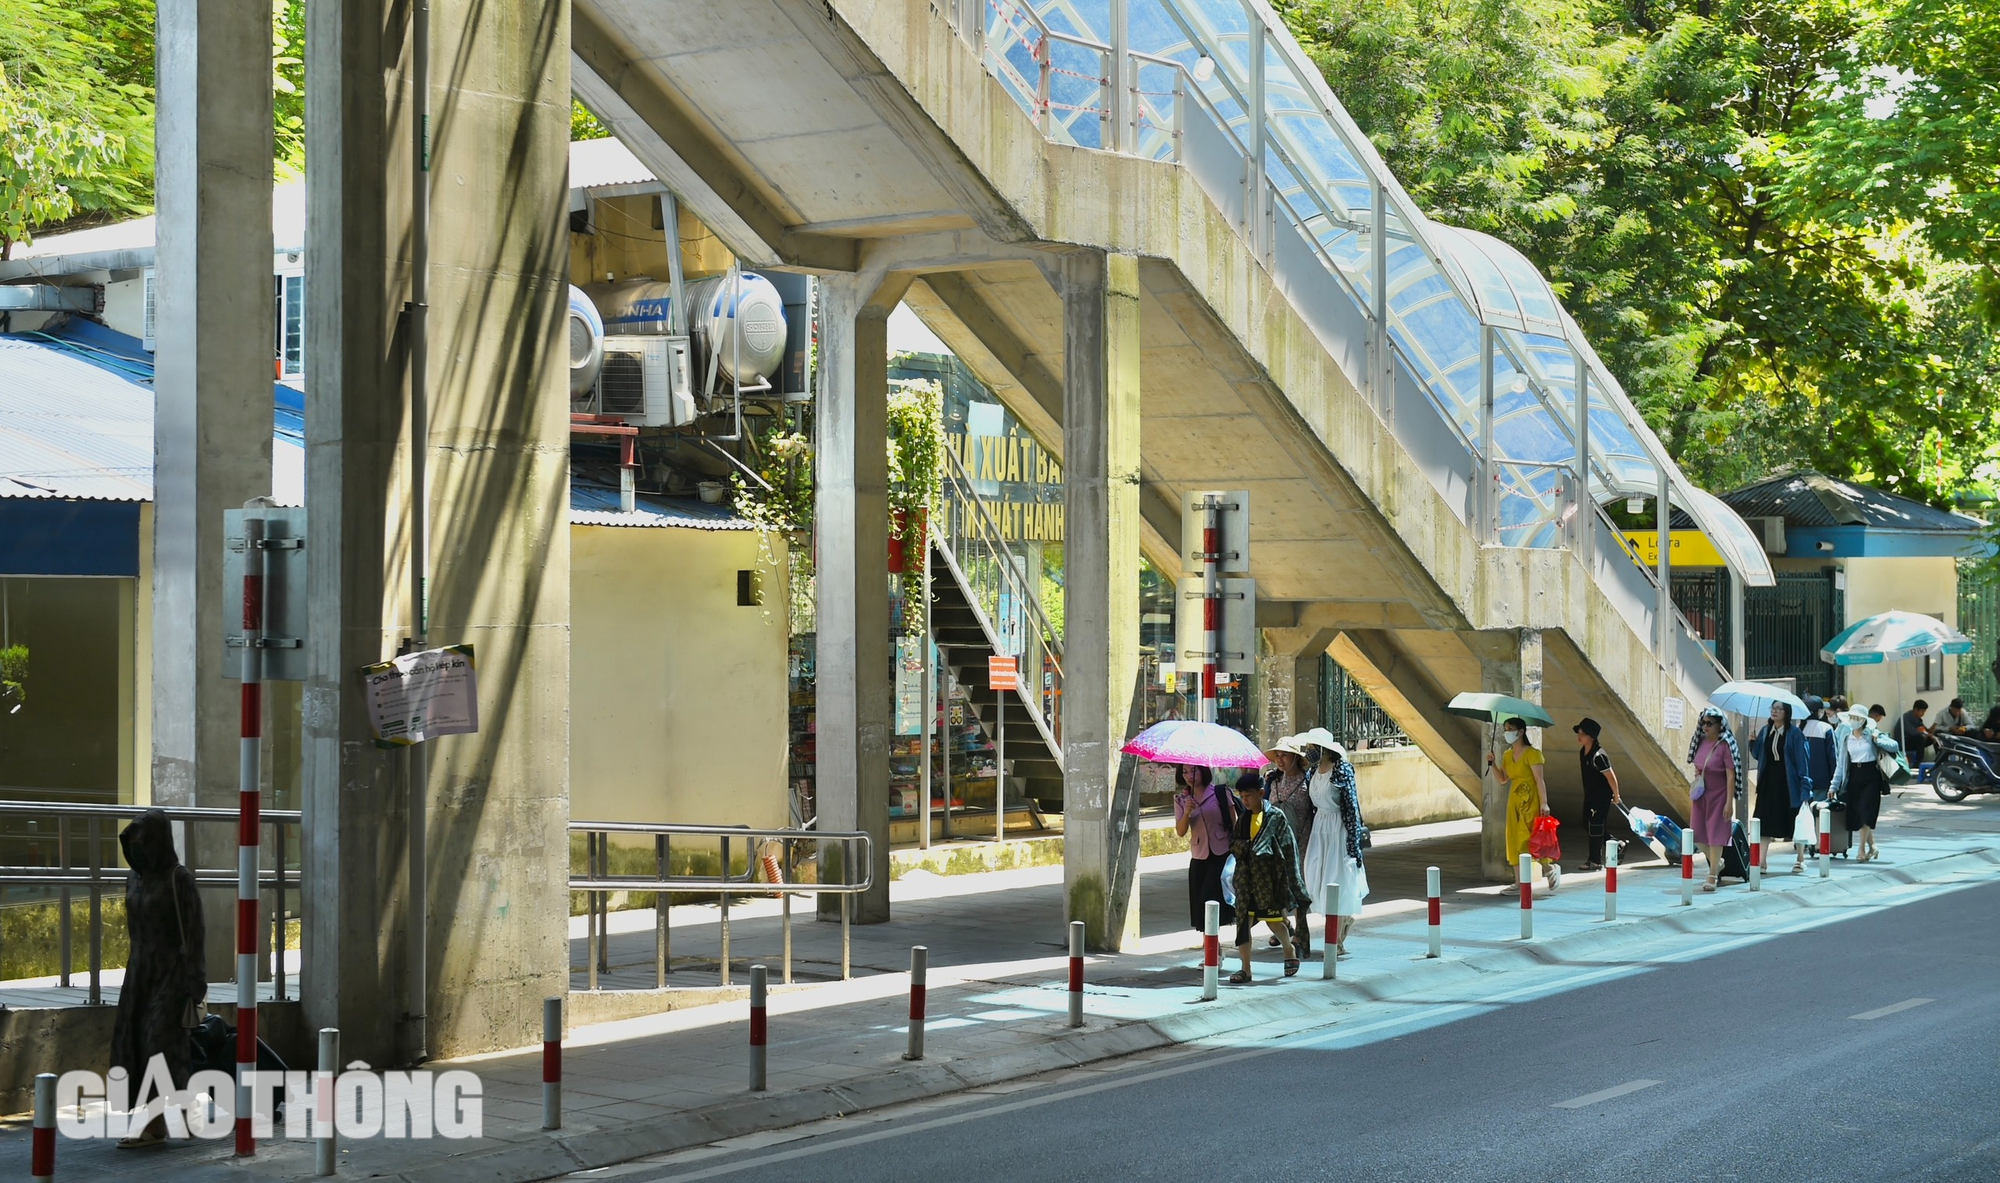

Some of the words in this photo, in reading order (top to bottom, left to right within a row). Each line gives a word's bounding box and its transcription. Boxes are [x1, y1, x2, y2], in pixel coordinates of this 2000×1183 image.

[746, 322, 777, 333] SONHA
[980, 421, 1031, 482] XUẤT
[980, 493, 1021, 541] PHÁT
[1023, 494, 1064, 540] HÀNH
[1909, 647, 1928, 657] Riki
[372, 675, 389, 686] Cho
